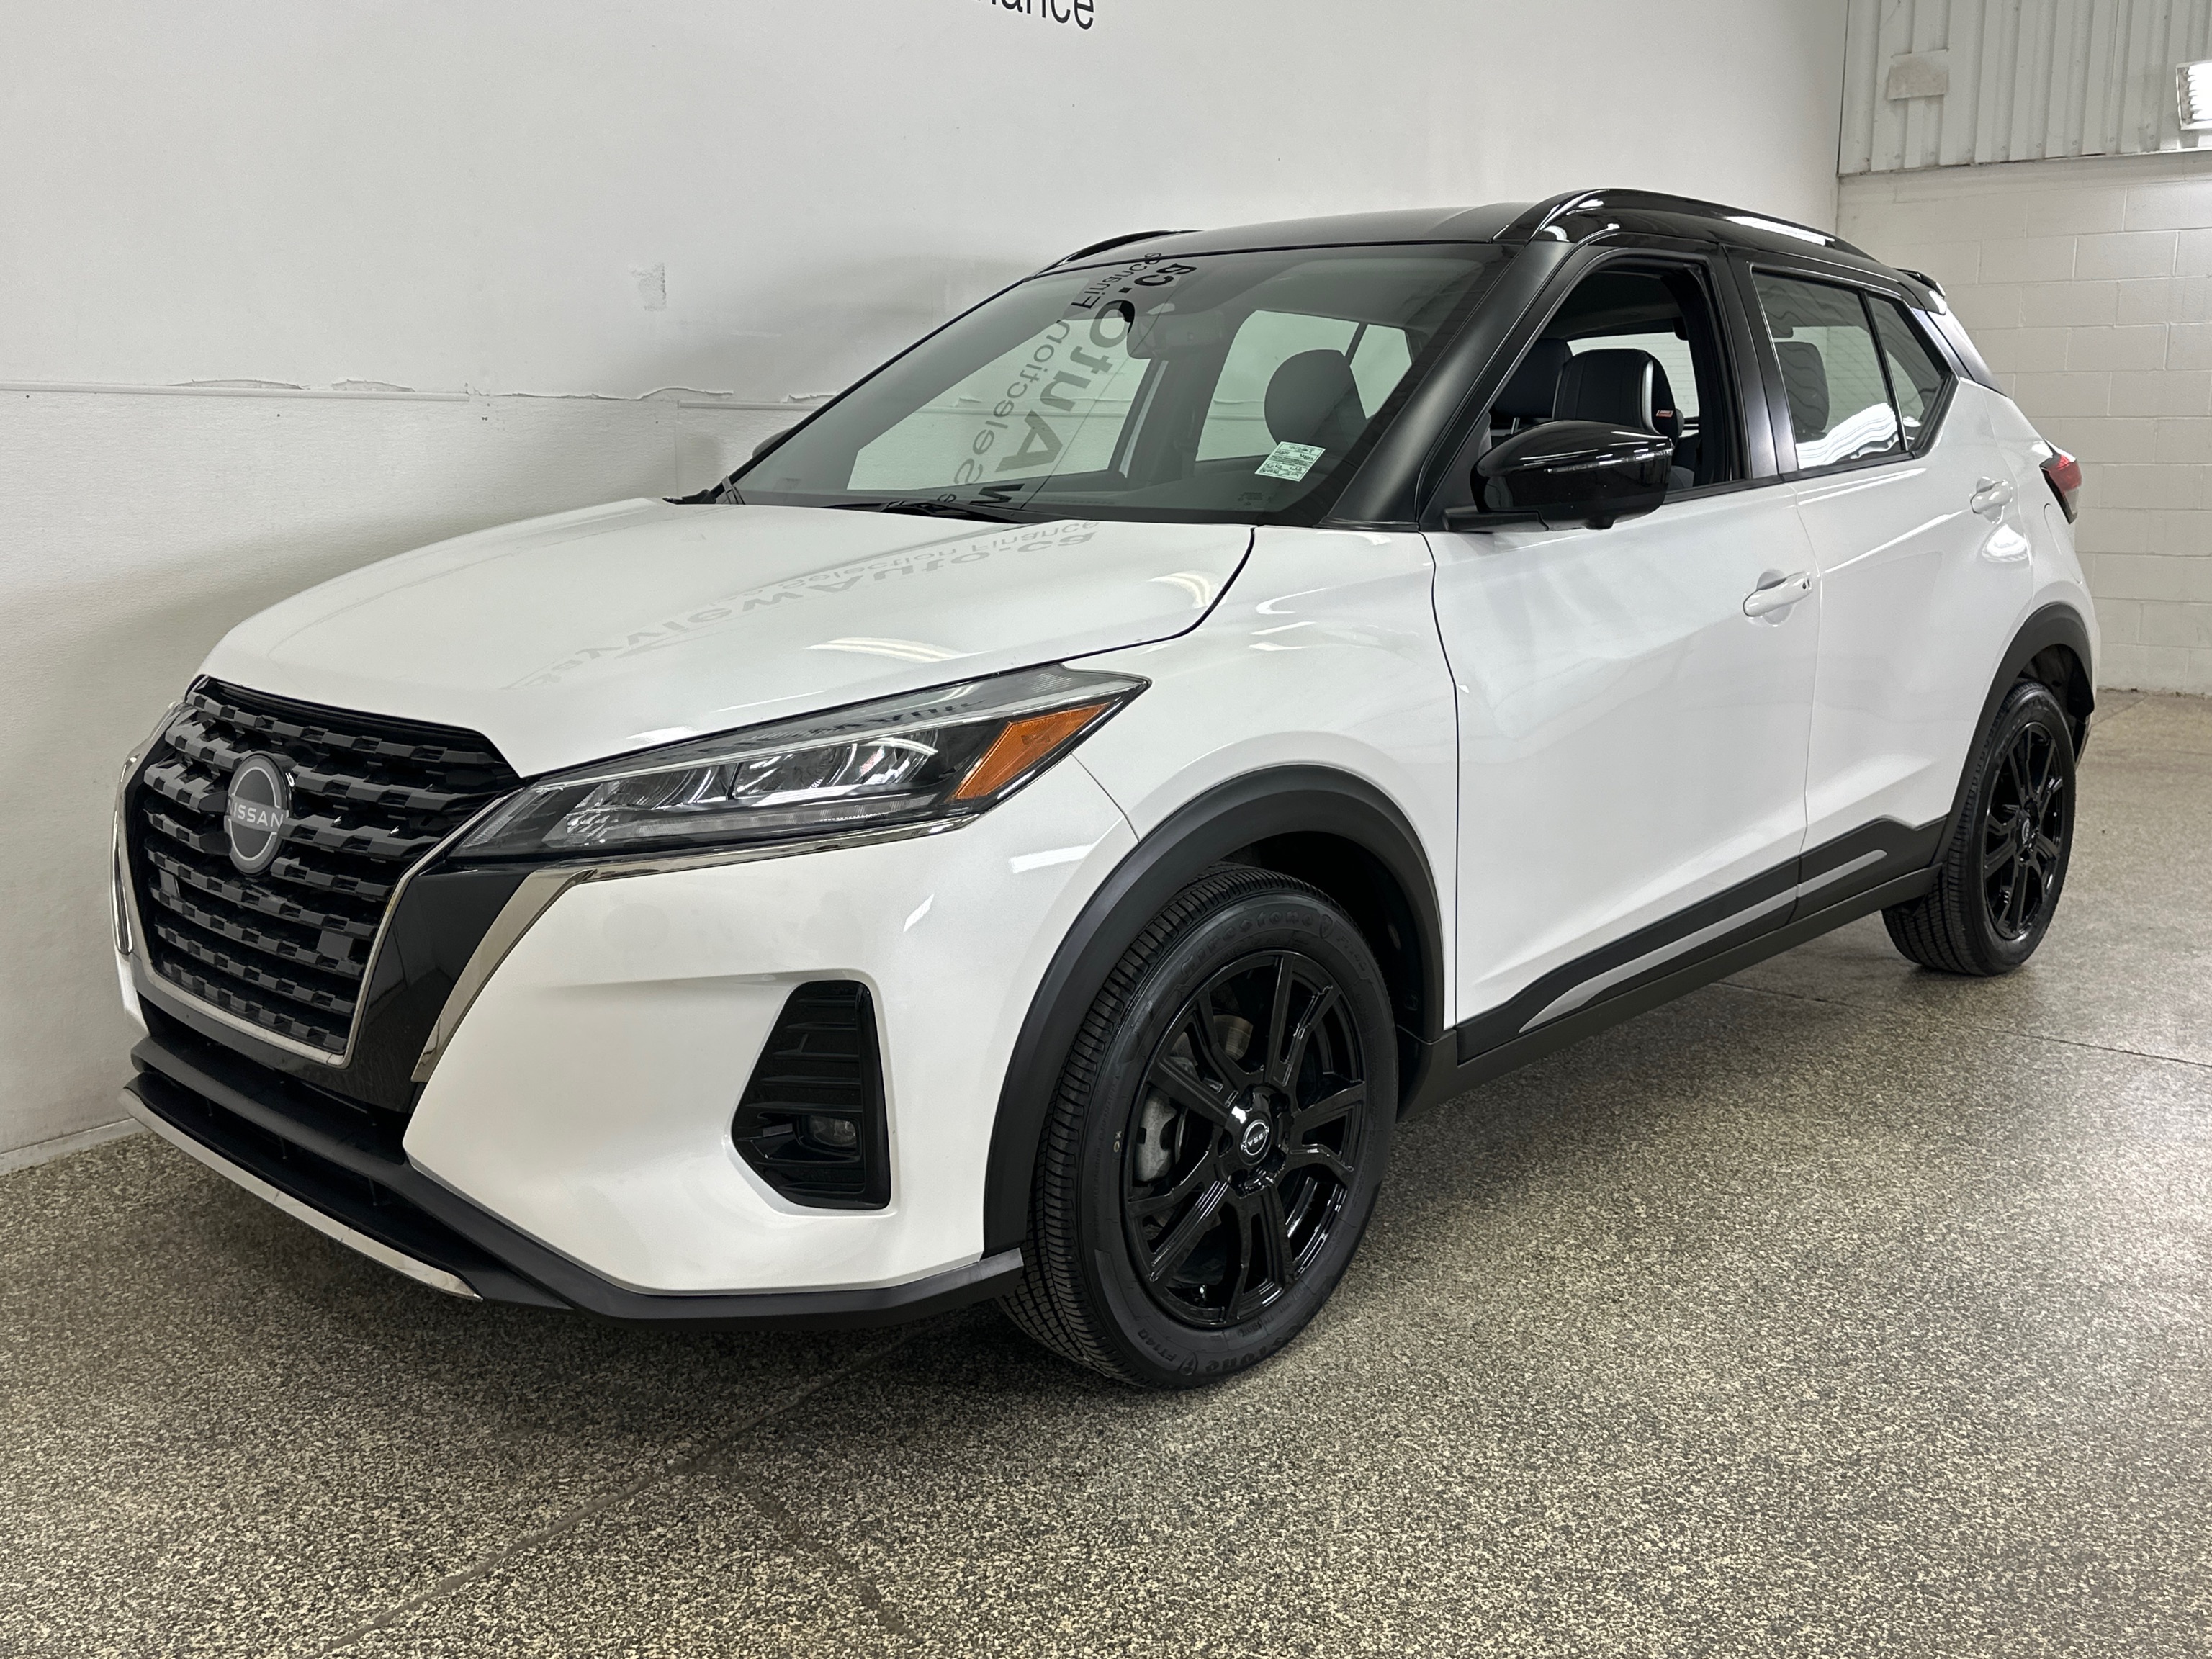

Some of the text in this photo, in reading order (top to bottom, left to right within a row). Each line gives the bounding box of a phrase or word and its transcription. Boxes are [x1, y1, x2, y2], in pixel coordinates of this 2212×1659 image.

[228, 799, 284, 828] NISSAN
[1239, 1125, 1270, 1152] NISSAN
[1136, 1328, 1178, 1362] FT140
